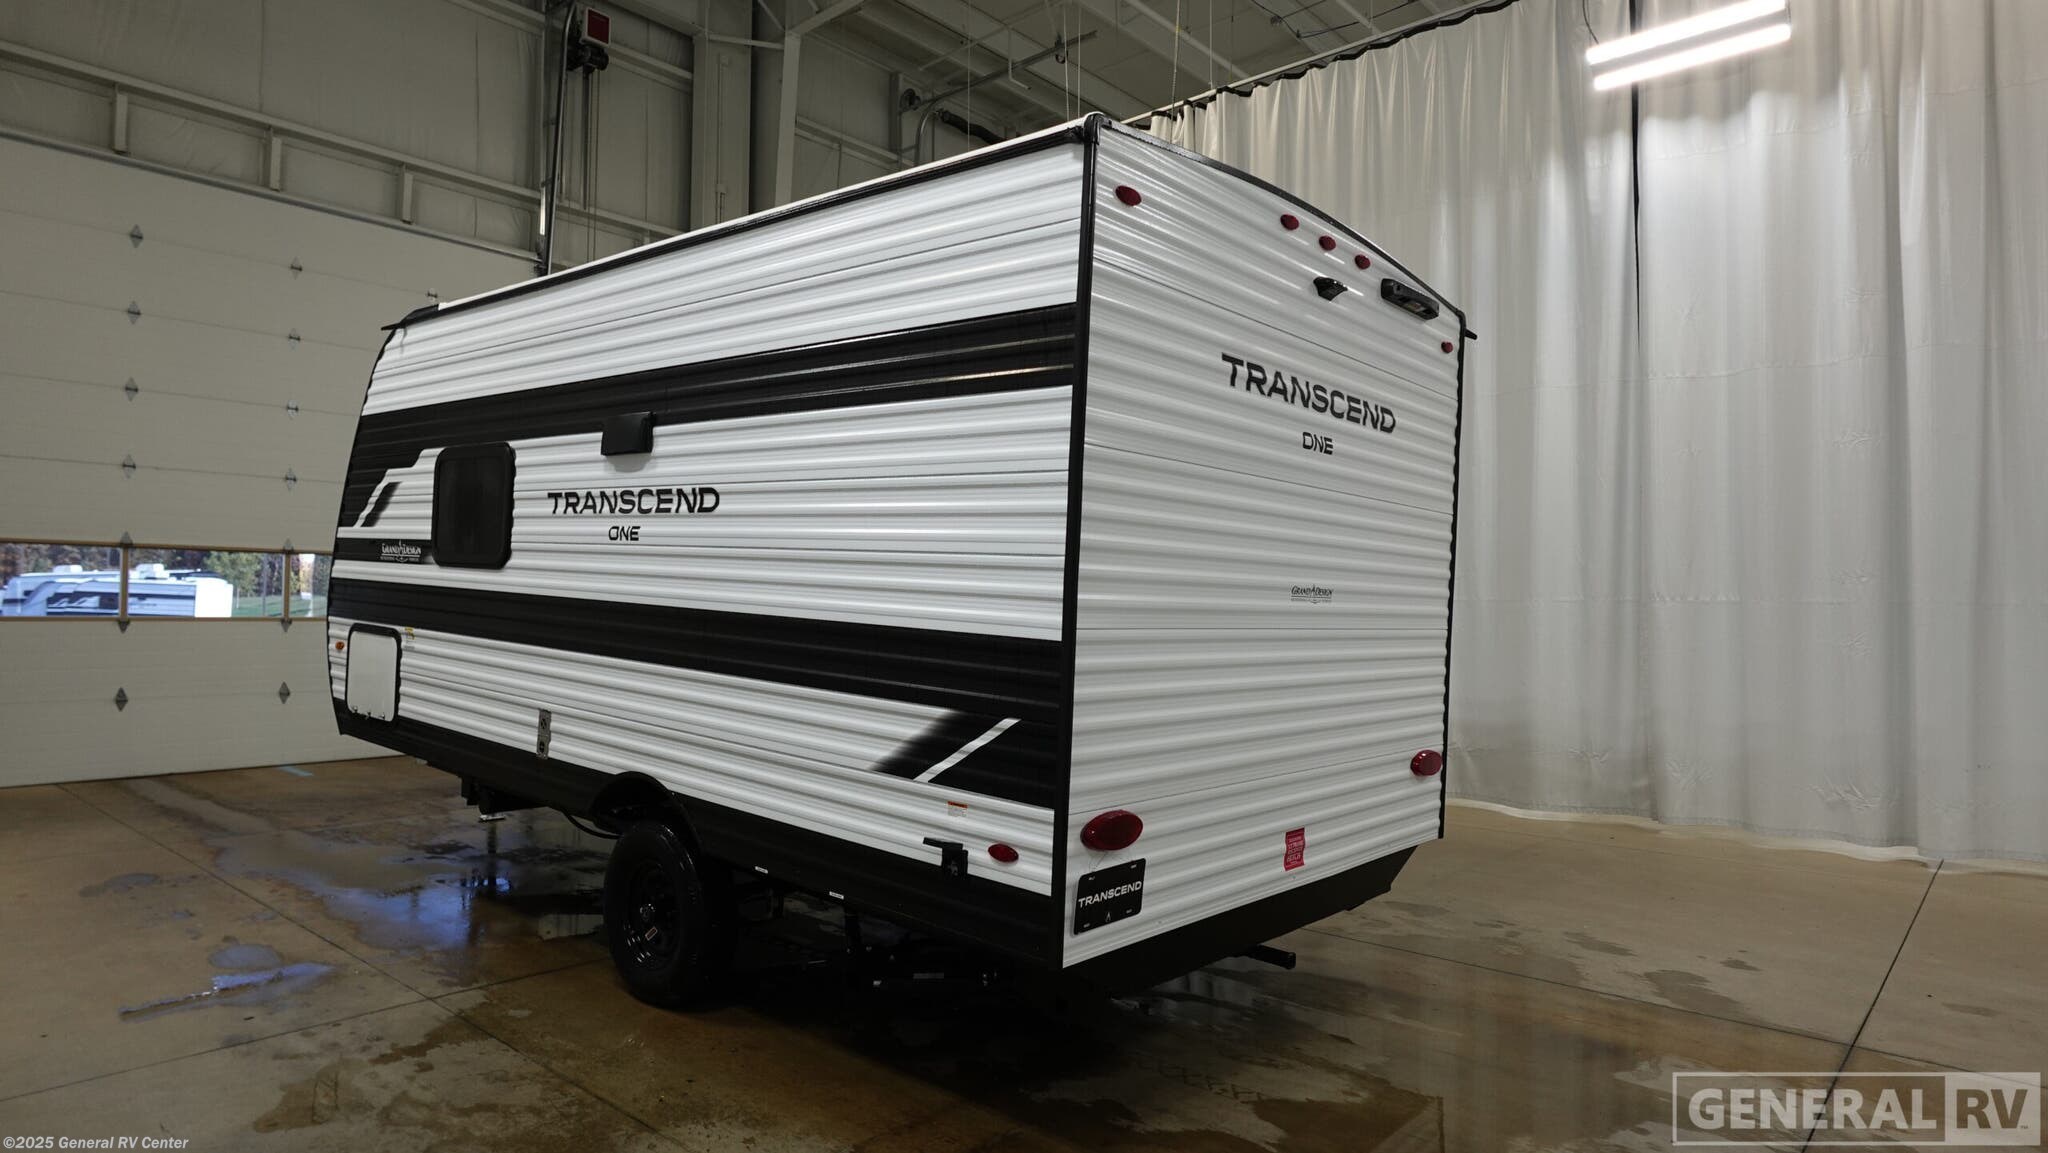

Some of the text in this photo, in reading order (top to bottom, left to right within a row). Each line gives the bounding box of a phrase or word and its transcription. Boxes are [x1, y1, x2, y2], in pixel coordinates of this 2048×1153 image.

[1221, 352, 1396, 434] TRANSCEND
[1302, 431, 1334, 455] ONE
[547, 487, 720, 515] TRANSCEND
[608, 525, 641, 541] ONE
[1078, 881, 1142, 908] TRANSCEND
